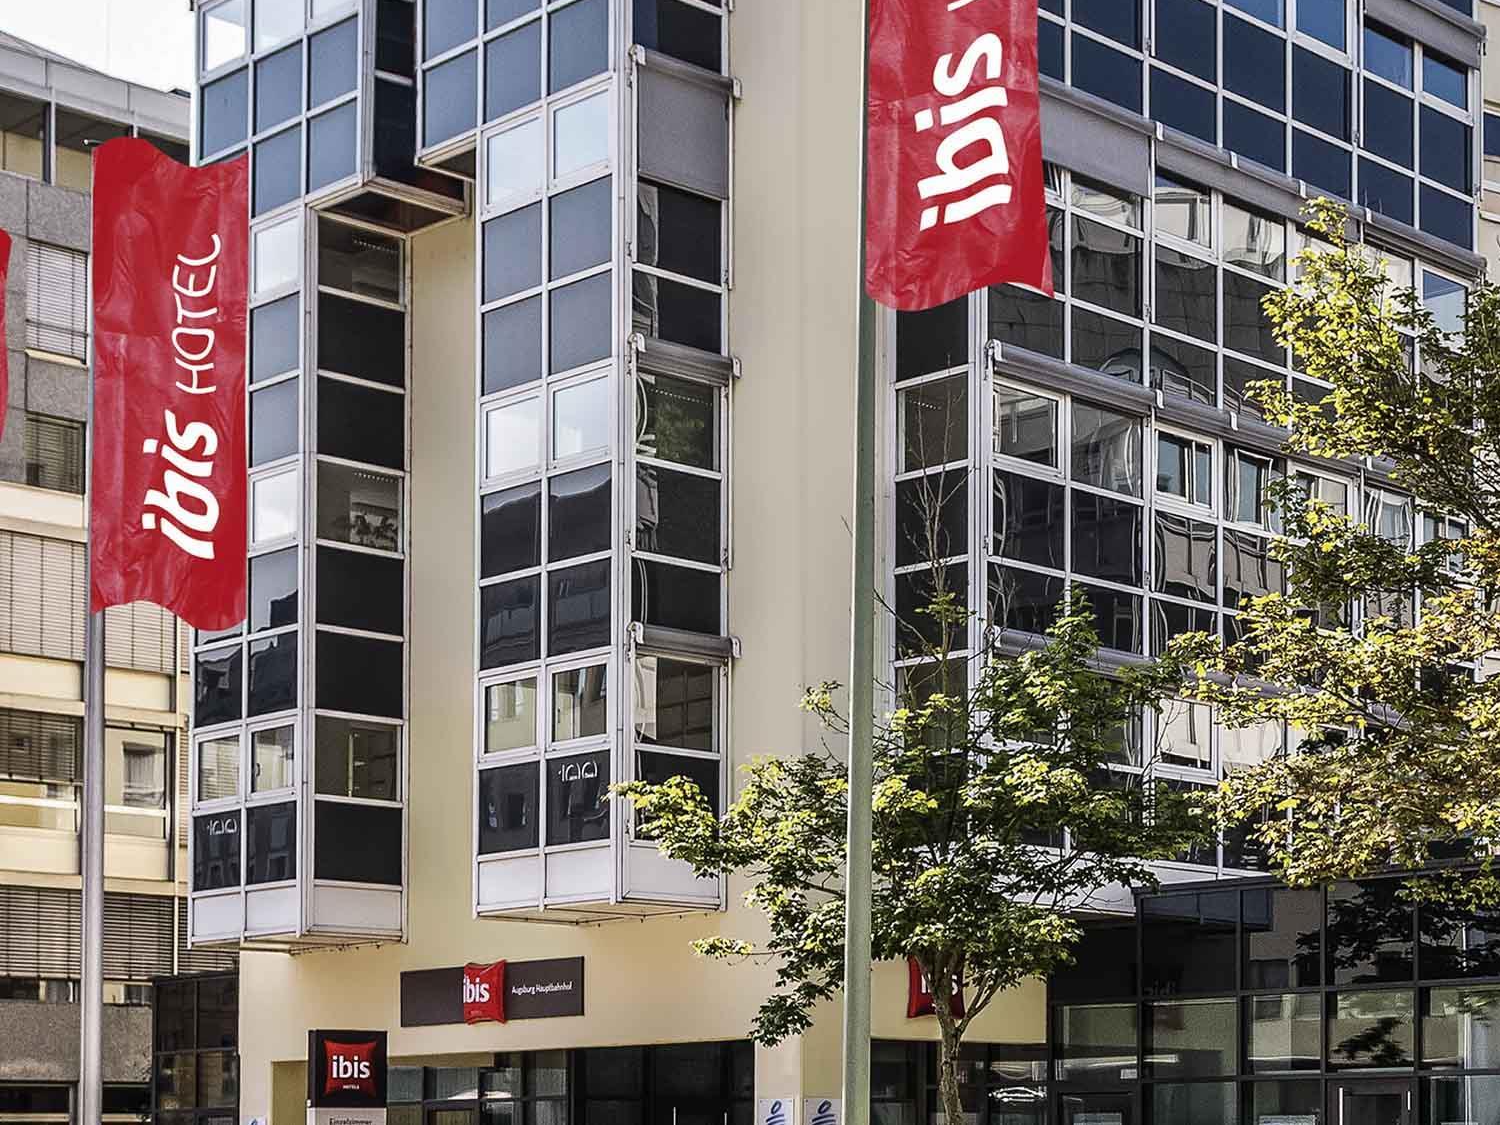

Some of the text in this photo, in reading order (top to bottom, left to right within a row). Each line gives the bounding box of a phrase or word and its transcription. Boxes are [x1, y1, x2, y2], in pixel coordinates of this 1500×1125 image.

[913, 32, 1013, 233] ibis
[142, 232, 222, 560] ibis HOTEL
[463, 974, 491, 1004] ibis
[511, 984, 535, 996] Augsburg
[331, 1054, 371, 1079] ibis
